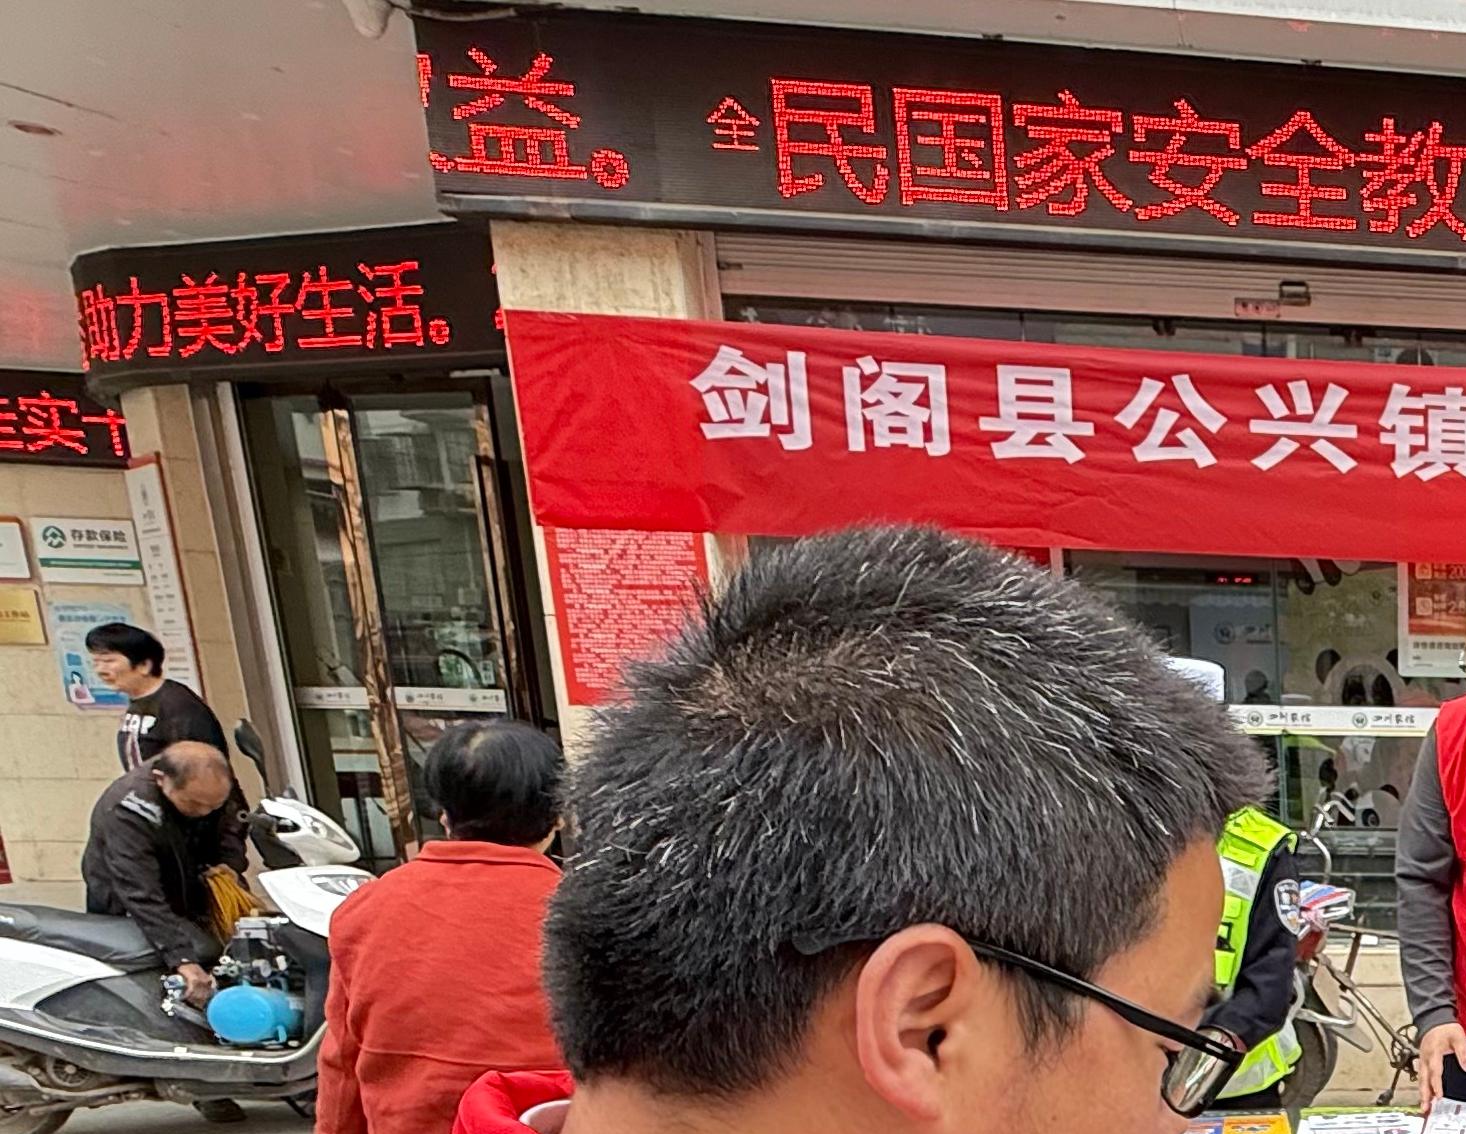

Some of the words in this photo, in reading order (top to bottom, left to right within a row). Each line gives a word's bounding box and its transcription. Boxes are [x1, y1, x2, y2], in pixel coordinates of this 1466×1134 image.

[416, 46, 630, 189] 益。
[80, 261, 450, 370] 助力美好生活。
[71, 529, 127, 543] 存款保险
